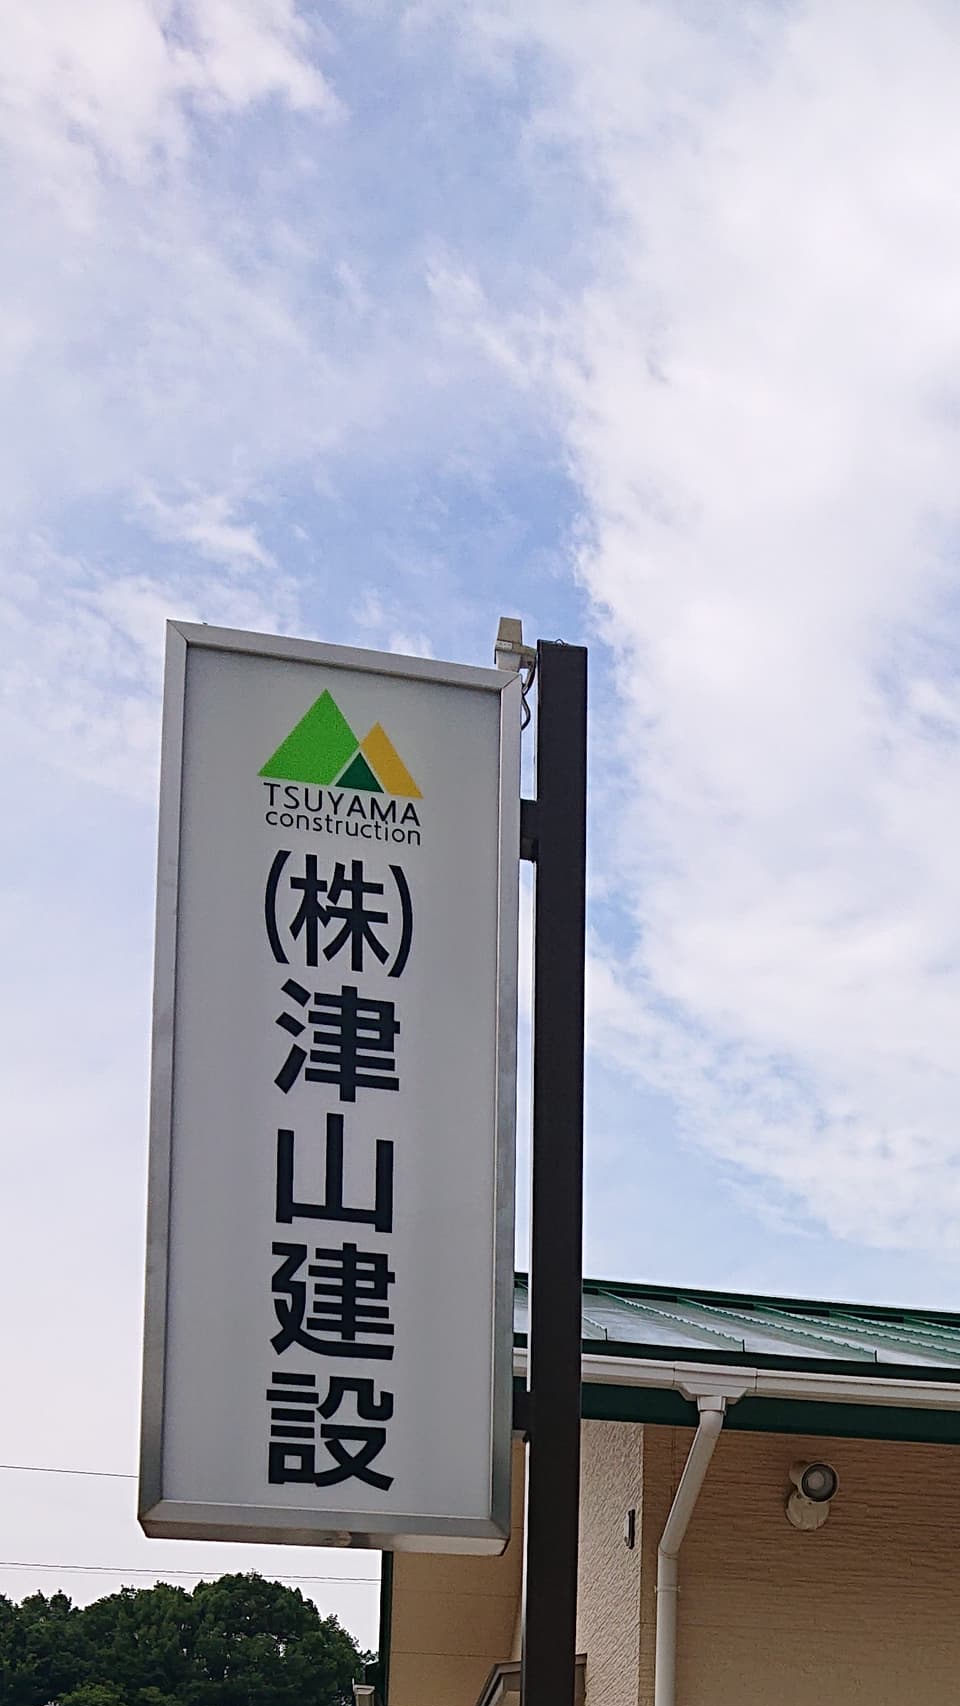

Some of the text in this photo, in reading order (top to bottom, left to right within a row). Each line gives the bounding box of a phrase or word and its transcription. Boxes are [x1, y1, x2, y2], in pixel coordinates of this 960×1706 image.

[264, 782, 421, 826] TSUYAMA
[266, 809, 421, 846] construction
[265, 850, 413, 1491] (株)津山建設
